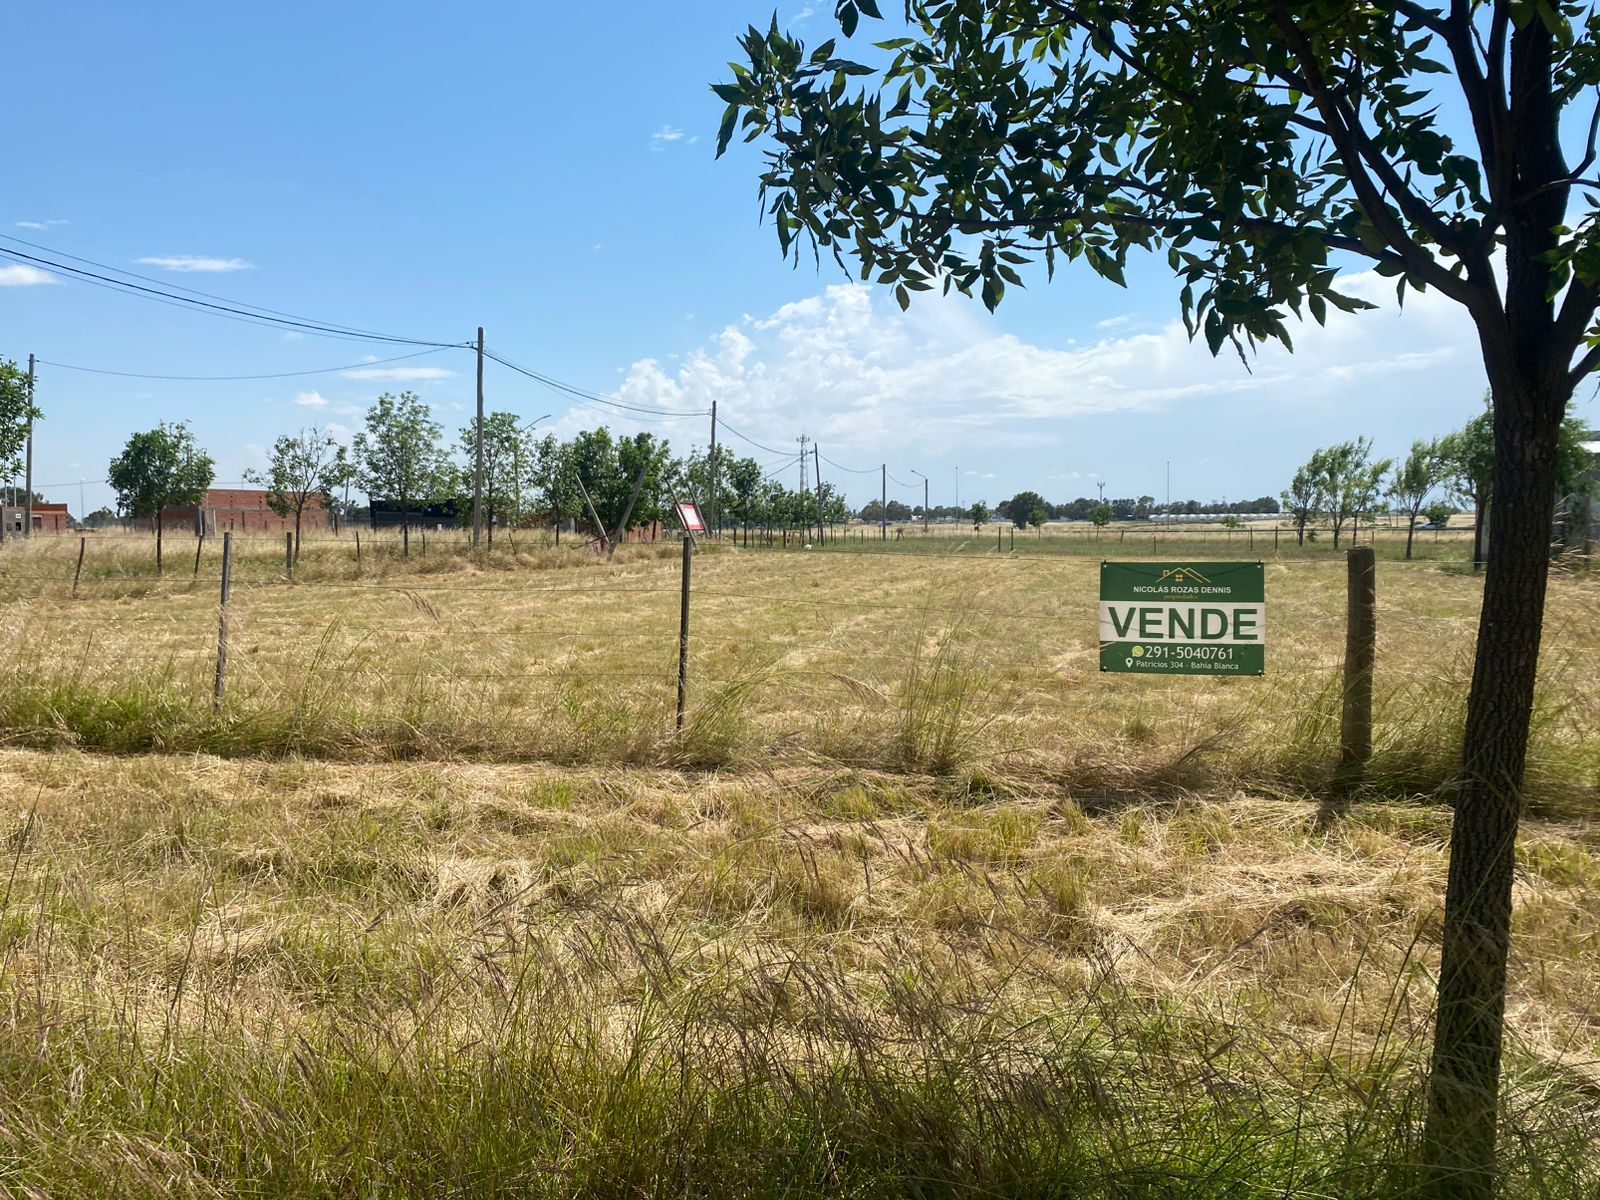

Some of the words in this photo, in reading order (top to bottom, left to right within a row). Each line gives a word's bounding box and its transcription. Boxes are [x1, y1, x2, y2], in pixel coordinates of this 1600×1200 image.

[1108, 607, 1258, 640] VENDE
[1145, 646, 1233, 660] 291-5040761
[1136, 660, 1168, 668] Patricios
[1214, 662, 1239, 670] Blanca
